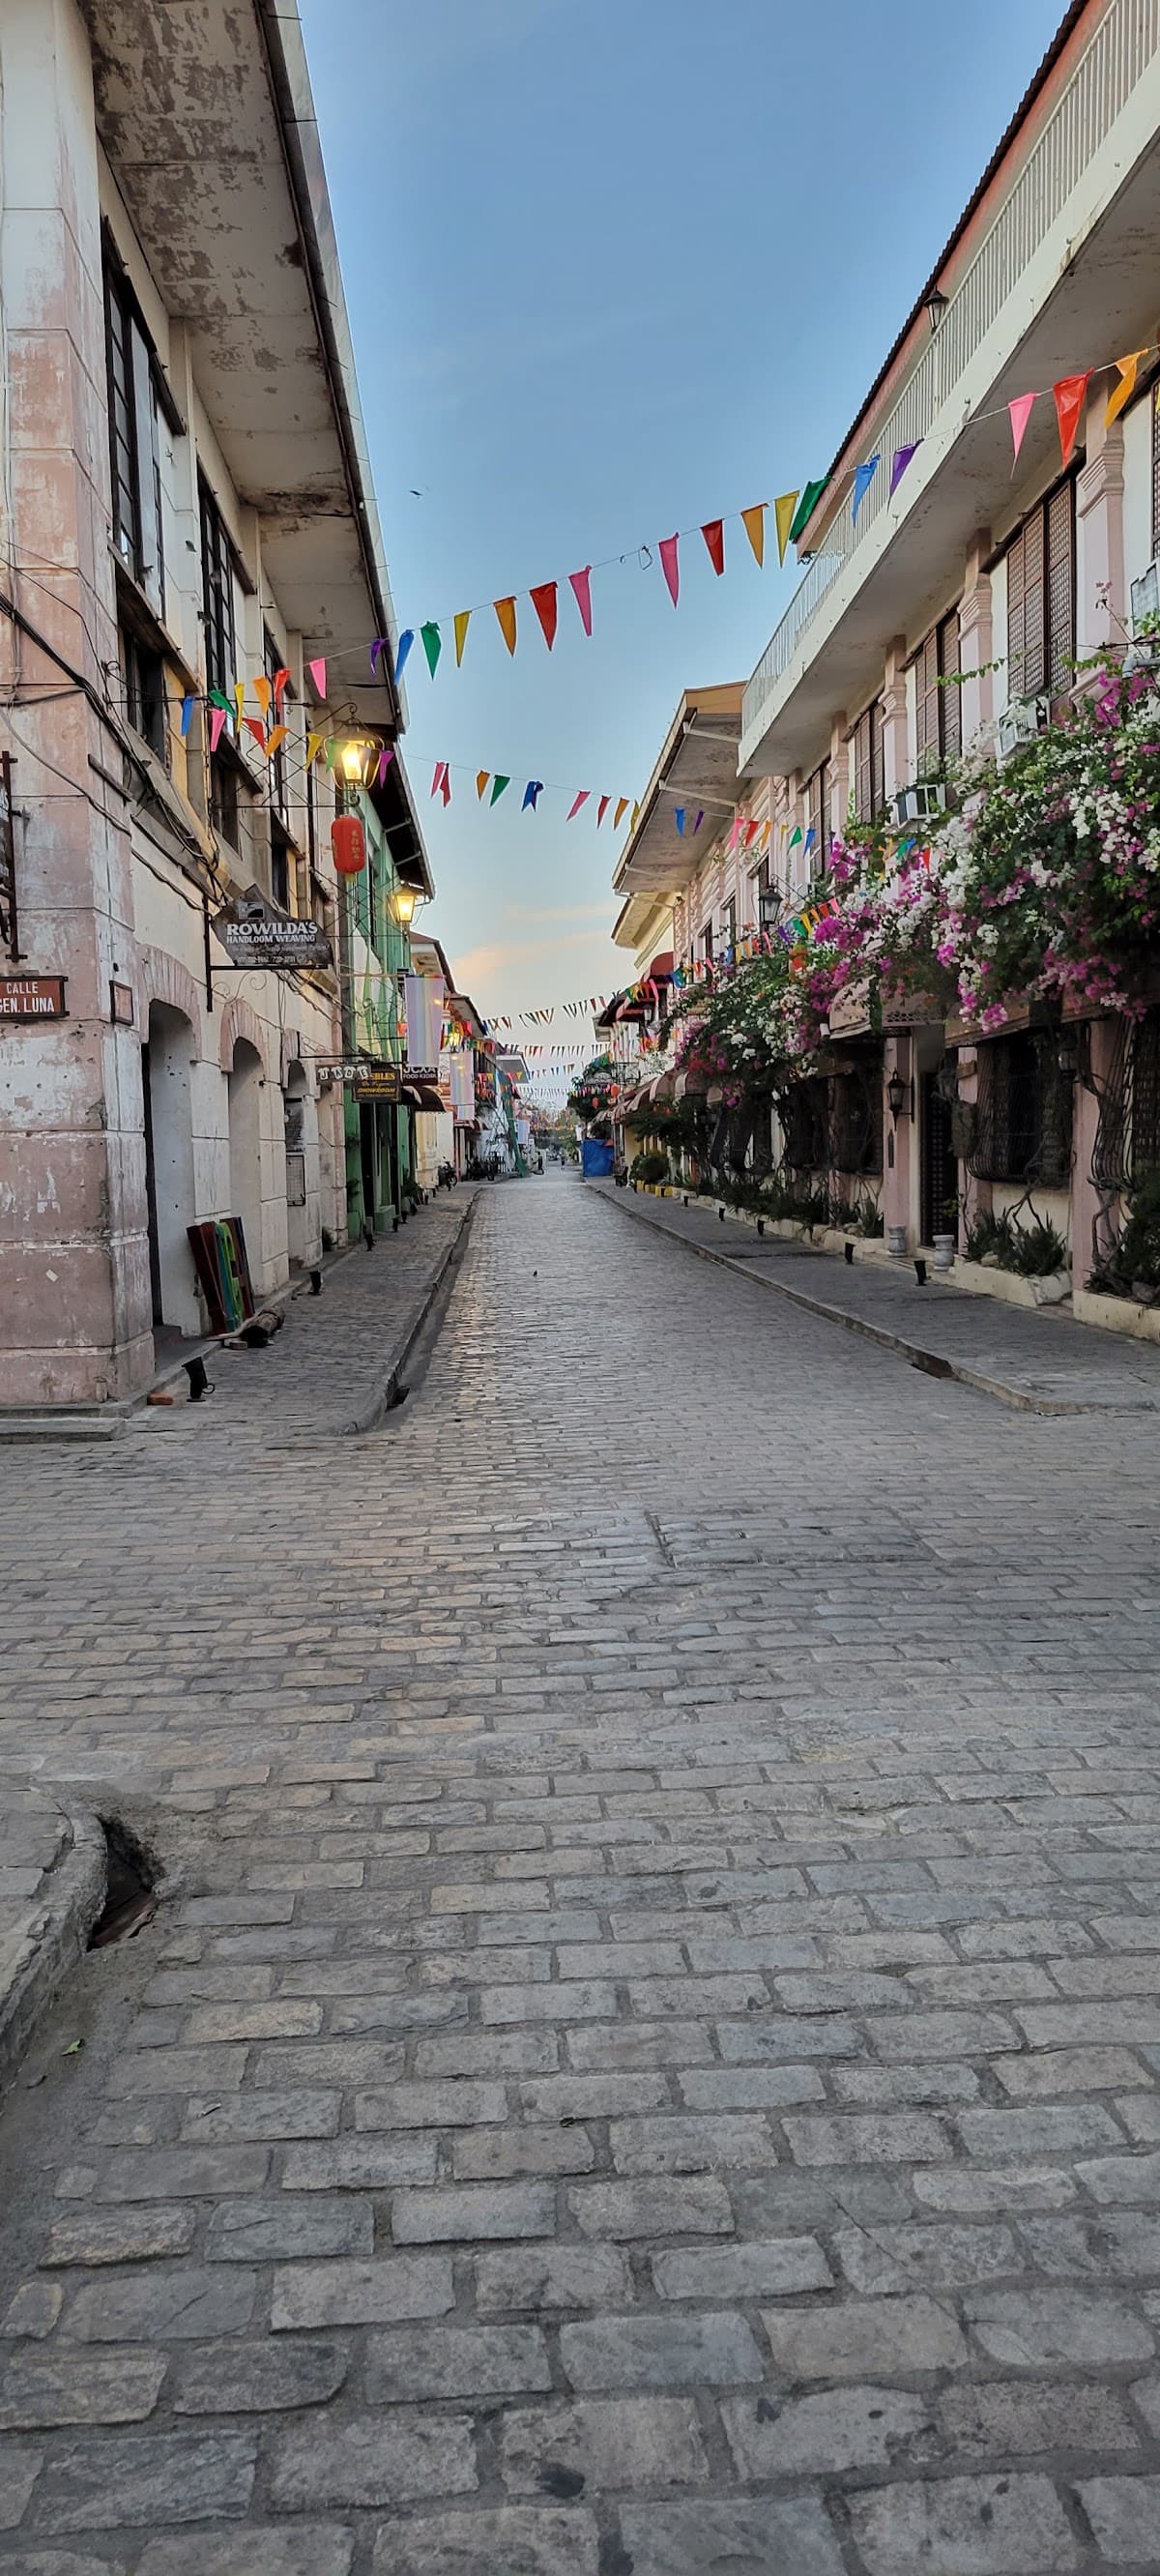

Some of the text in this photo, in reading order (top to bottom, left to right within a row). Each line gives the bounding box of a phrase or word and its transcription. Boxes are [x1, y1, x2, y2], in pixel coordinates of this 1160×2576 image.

[226, 922, 318, 936] ROWILDA'S
[226, 934, 315, 944] HANDLOOM WEAVING
[6, 981, 39, 994] CALLE
[23, 997, 55, 1012] LUNA
